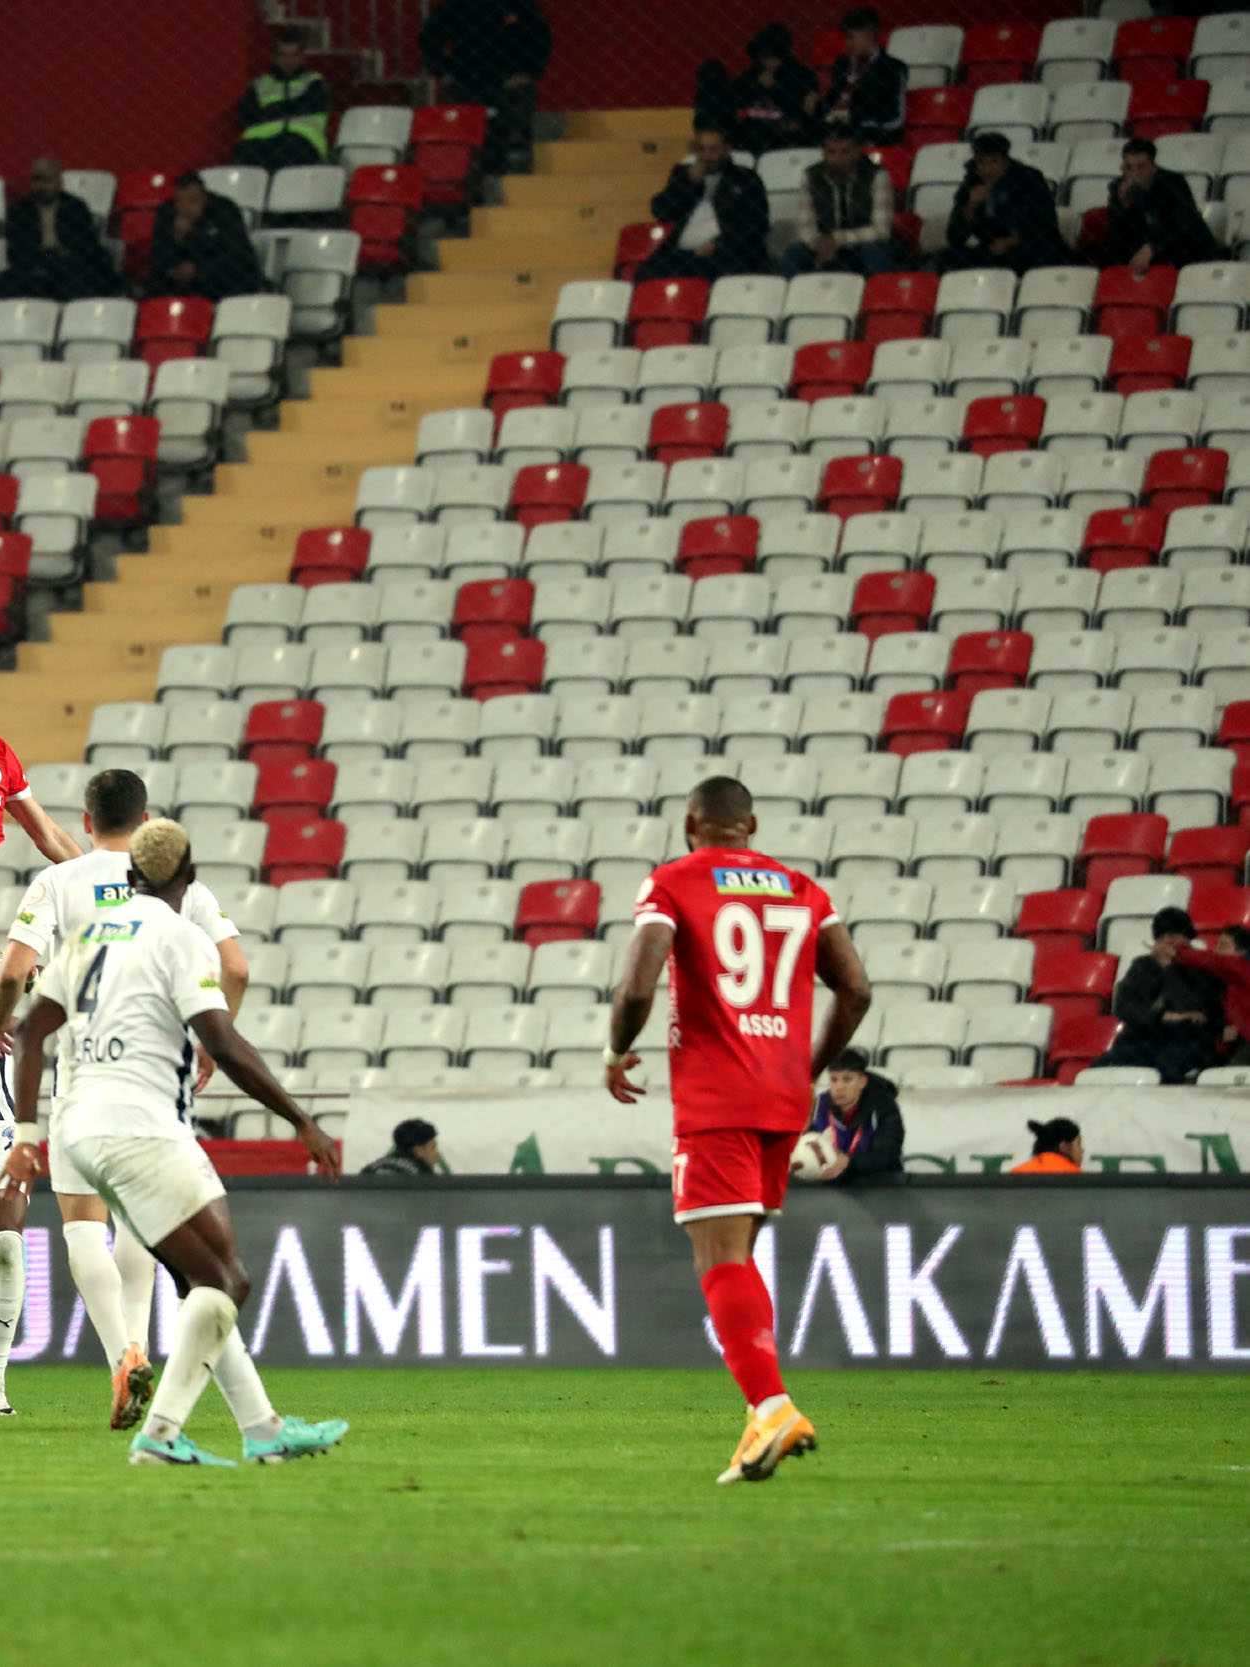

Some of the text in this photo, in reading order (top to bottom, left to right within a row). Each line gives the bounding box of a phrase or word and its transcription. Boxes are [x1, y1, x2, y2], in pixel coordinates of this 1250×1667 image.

[724, 871, 784, 891] aksa
[713, 902, 812, 1009] 97
[739, 1014, 787, 1038] ASSO
